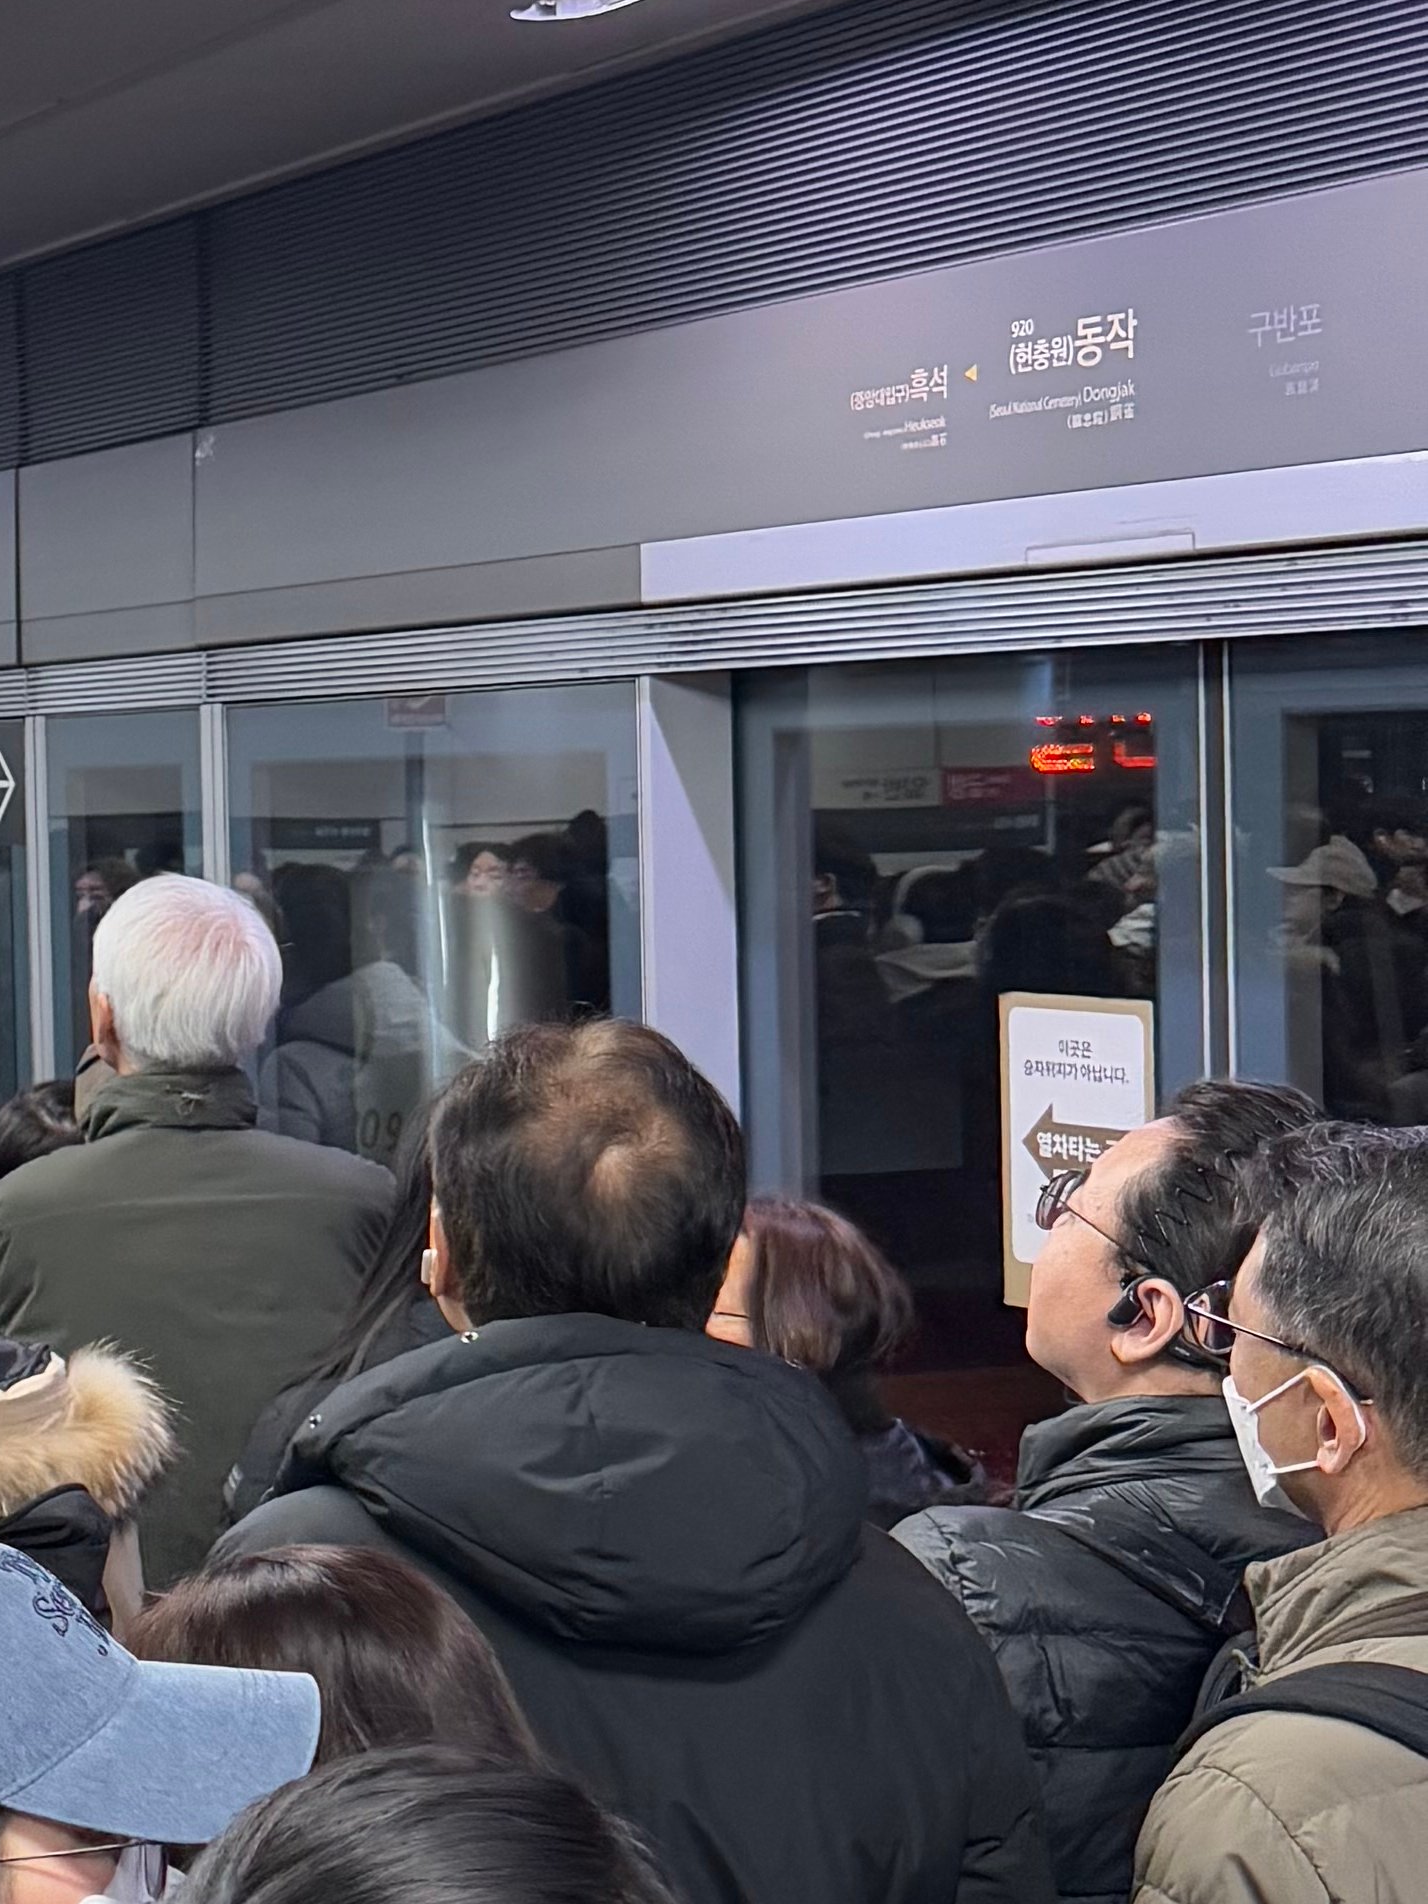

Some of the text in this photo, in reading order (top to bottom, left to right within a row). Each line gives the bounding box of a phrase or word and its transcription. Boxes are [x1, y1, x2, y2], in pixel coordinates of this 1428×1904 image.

[1011, 318, 1034, 338] 920
[1248, 303, 1323, 347] 구반포
[1083, 379, 1135, 404] Dongjak
[1058, 1039, 1093, 1059] 이곳은
[1080, 1063, 1130, 1084] 아닙니다.
